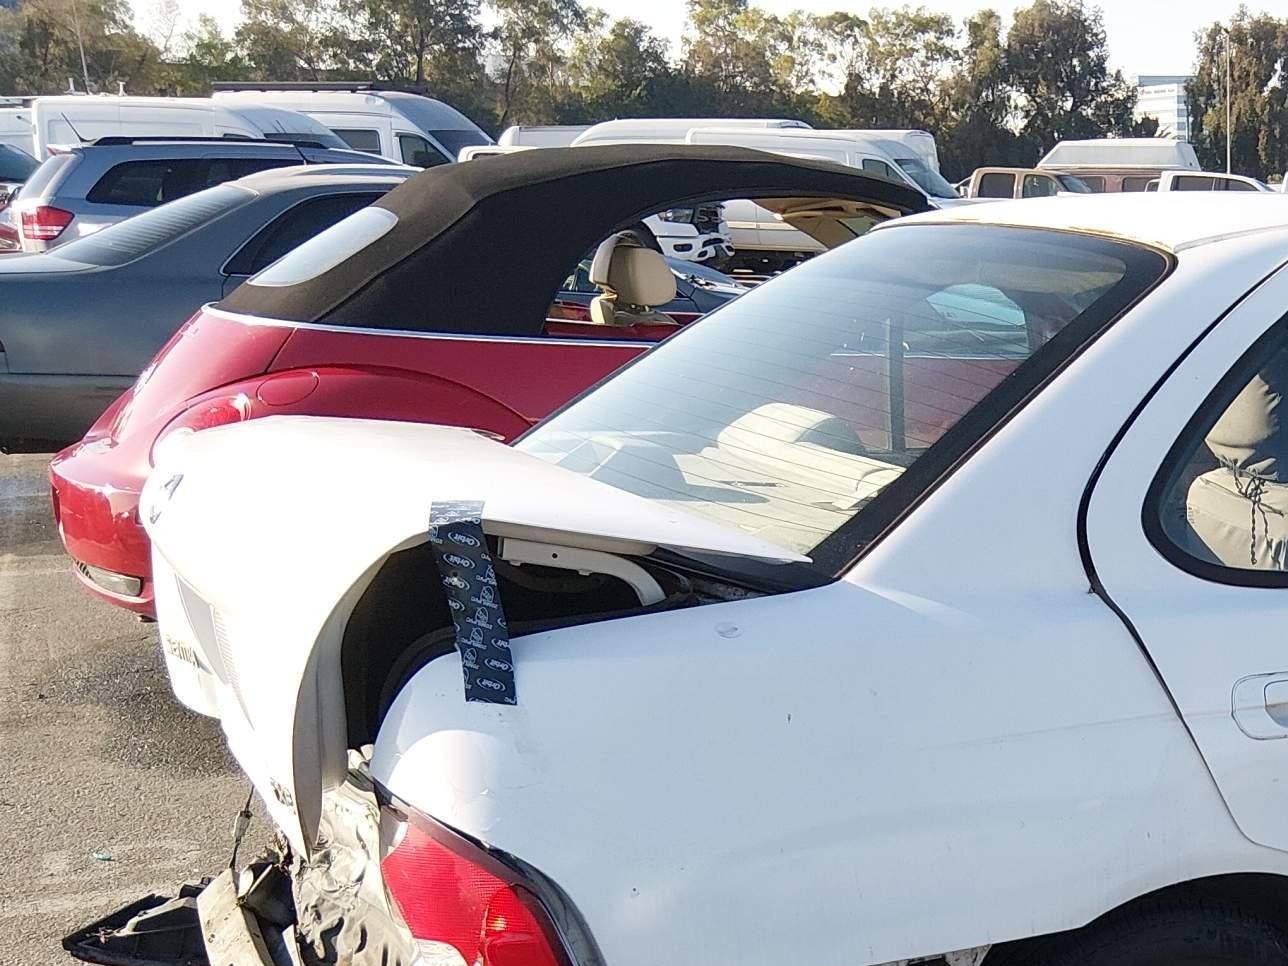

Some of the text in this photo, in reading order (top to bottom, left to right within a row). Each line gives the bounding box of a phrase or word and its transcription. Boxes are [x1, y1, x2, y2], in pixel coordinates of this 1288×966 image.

[454, 533, 475, 546] Orbit
[448, 555, 470, 567] Orbit
[490, 659, 509, 670] Orbit
[481, 679, 501, 689] Orbit
